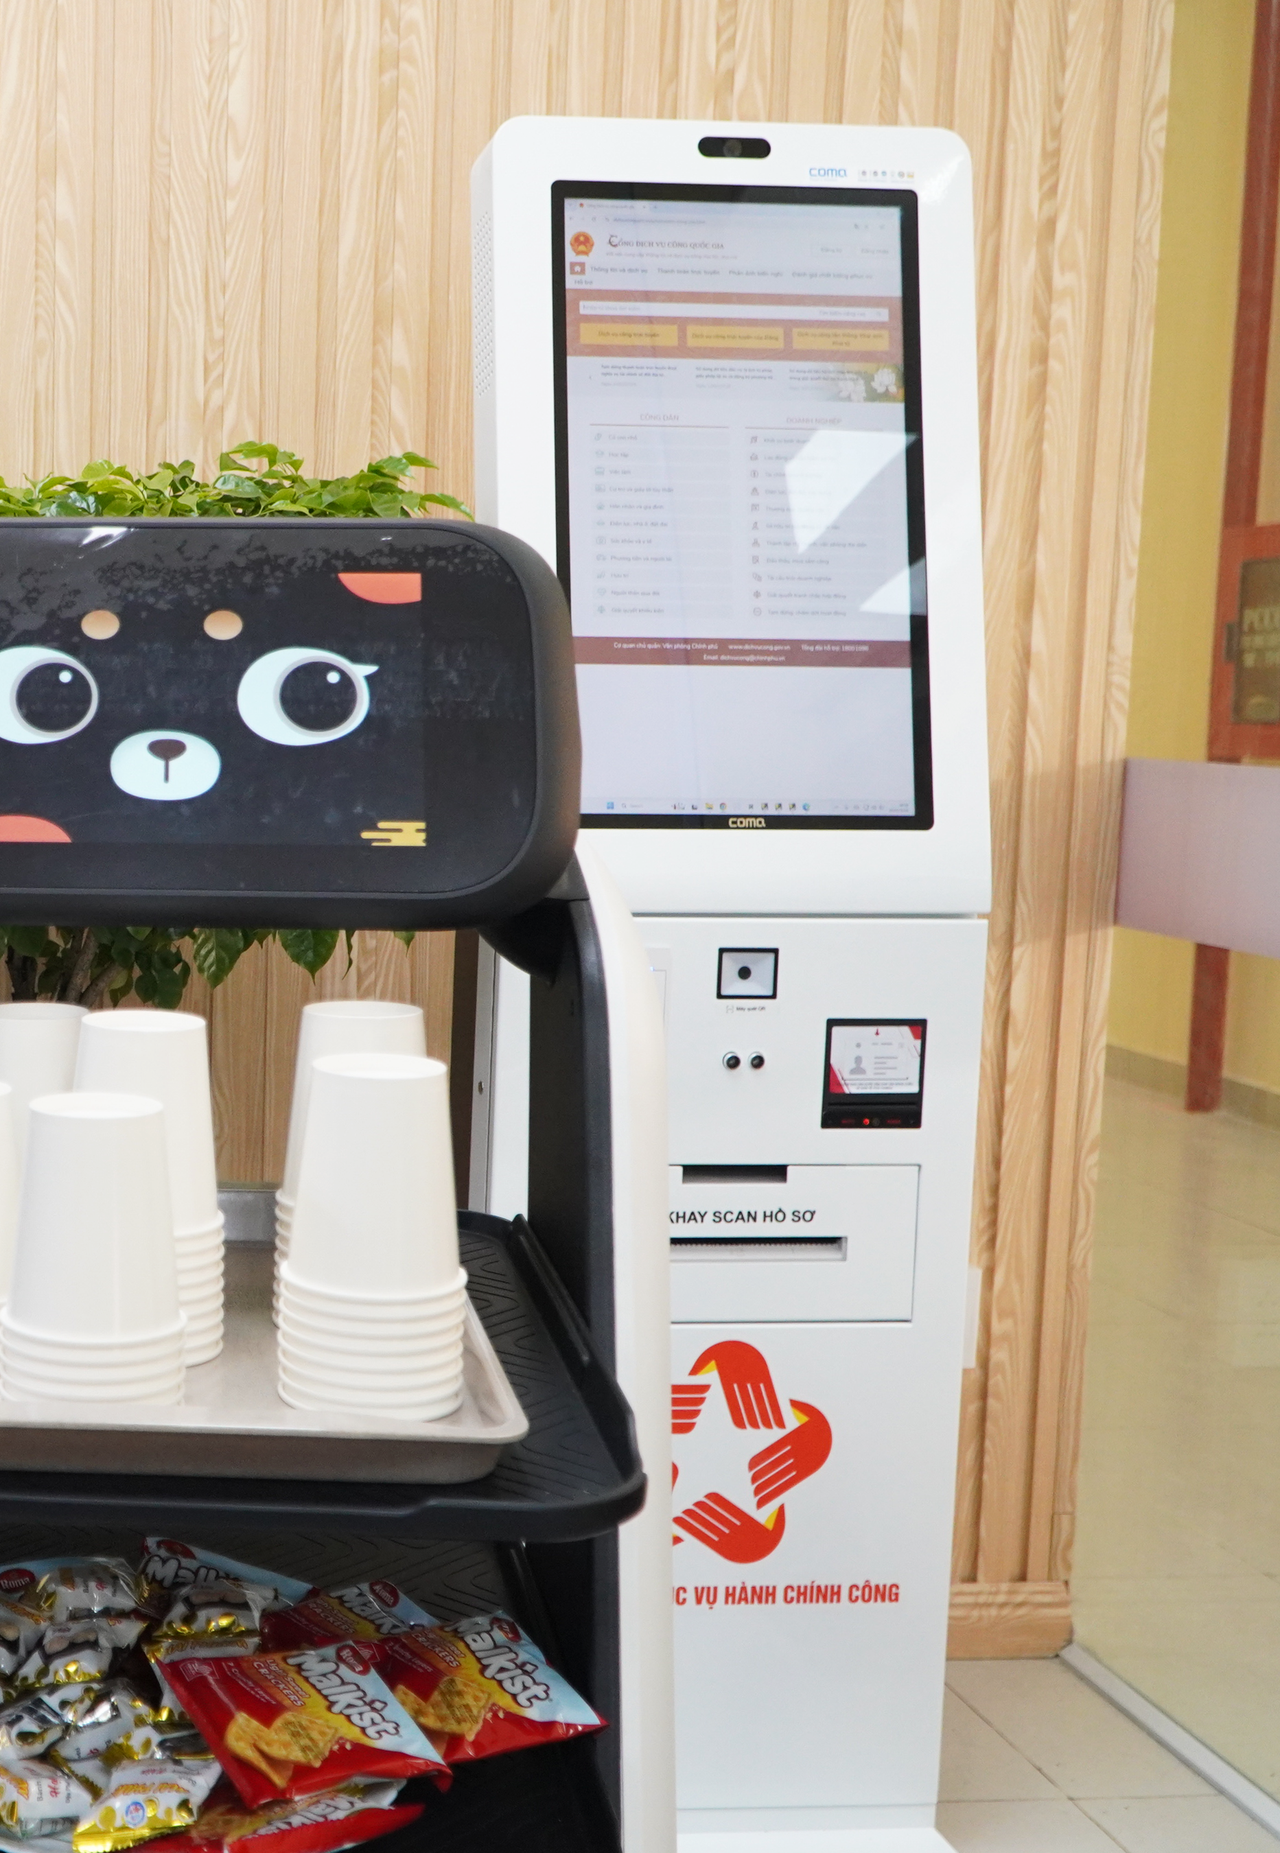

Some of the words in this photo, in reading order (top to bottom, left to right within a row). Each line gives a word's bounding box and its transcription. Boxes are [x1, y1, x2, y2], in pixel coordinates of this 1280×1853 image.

[712, 1210, 757, 1224] SCAN
[763, 1207, 786, 1223] HỒ
[791, 1210, 816, 1223] SƠ
[0, 1576, 31, 1590] Roma
[694, 1586, 718, 1610] VỤ
[724, 1581, 777, 1605] HÀNH
[783, 1580, 841, 1604] CHÍNH
[848, 1579, 900, 1603] CÔNG
[329, 1585, 411, 1636] Malk
[339, 1648, 363, 1673] Roma
[443, 1618, 550, 1709] Malkist
[252, 1661, 306, 1707] CRACKERS
[286, 1651, 401, 1741] Malkist
